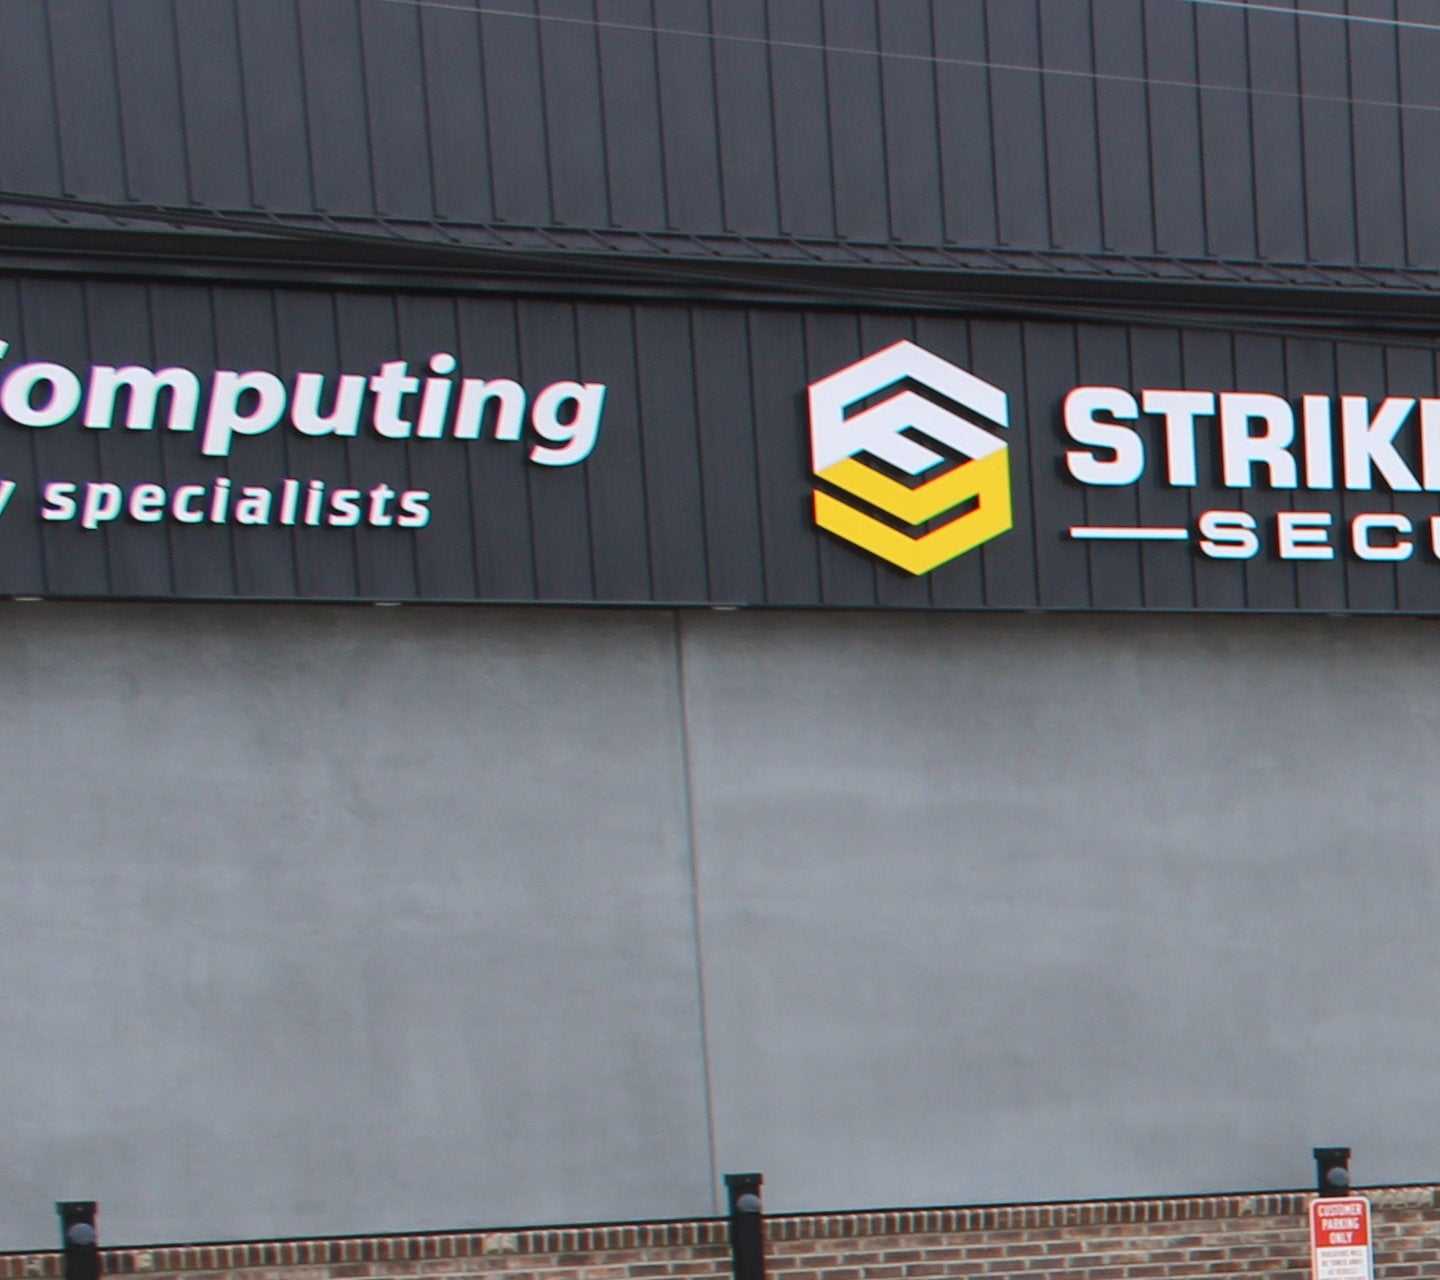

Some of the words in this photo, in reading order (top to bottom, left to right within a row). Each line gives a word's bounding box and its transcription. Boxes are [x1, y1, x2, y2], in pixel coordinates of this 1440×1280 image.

[0, 340, 605, 465] omputing
[41, 478, 431, 528] specialists
[1322, 1218, 1360, 1230] PARKING
